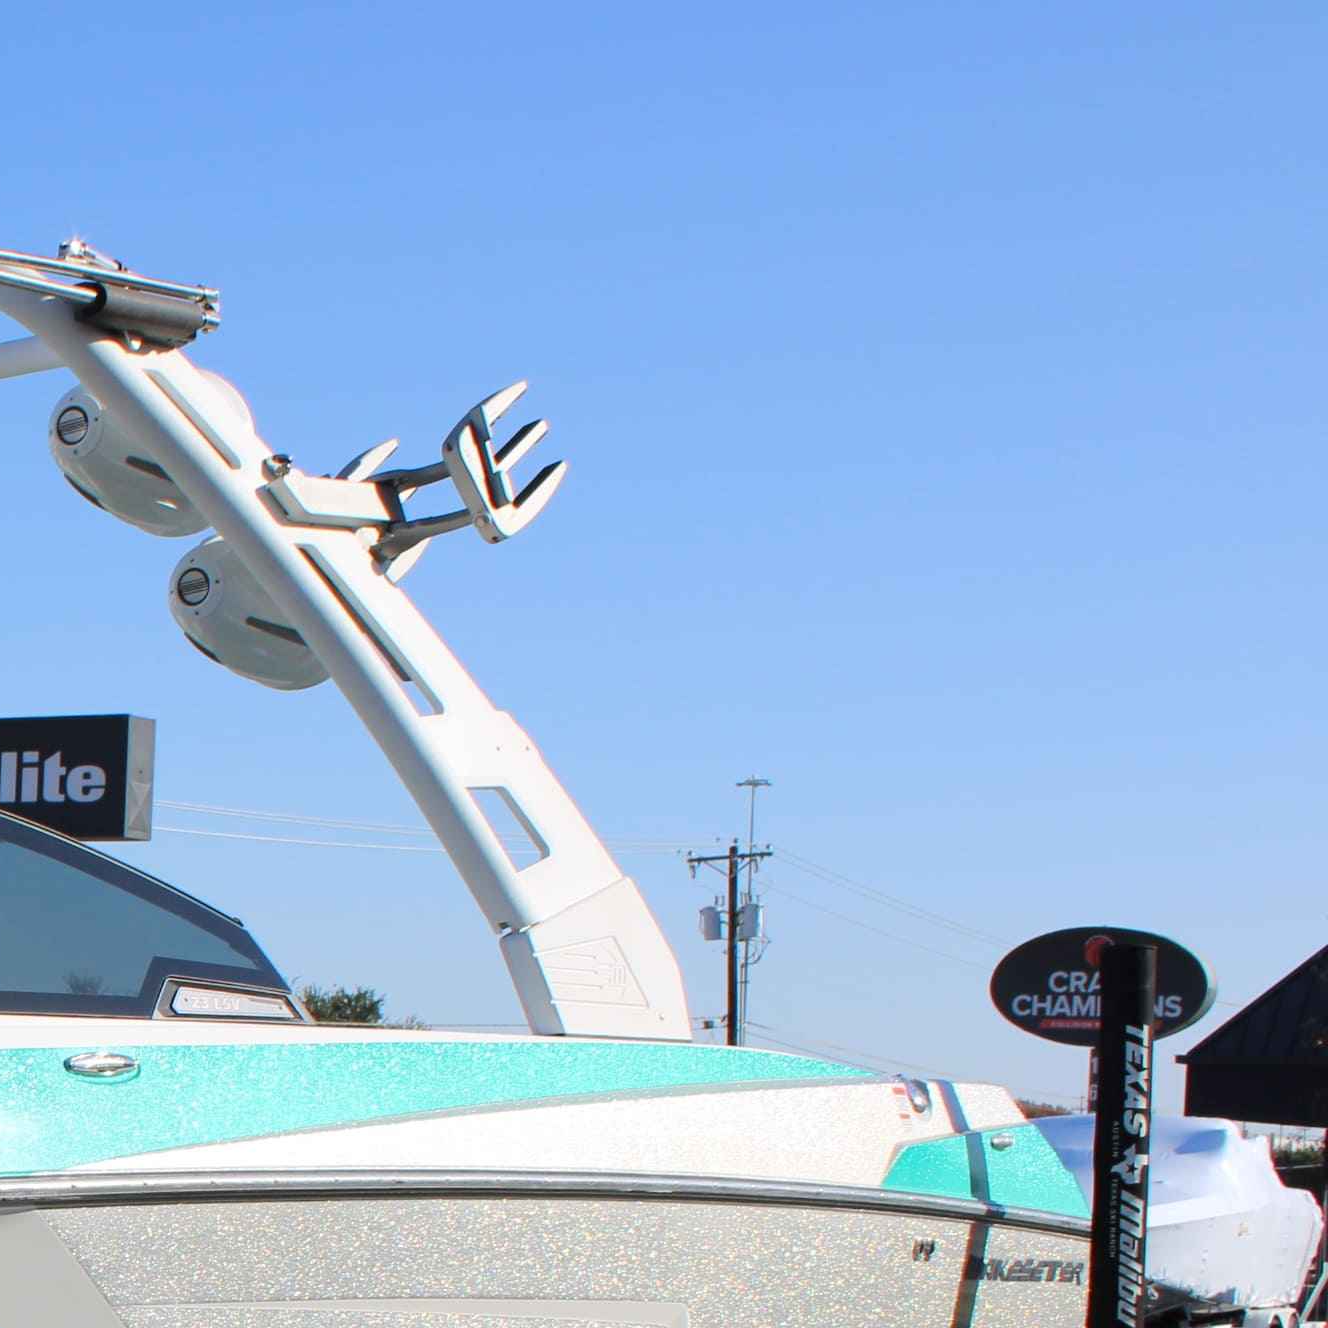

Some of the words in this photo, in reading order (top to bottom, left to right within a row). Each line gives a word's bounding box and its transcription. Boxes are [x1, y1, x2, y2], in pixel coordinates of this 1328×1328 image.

[1011, 994, 1182, 1018] CHAMNS
[1123, 1024, 1150, 1138] TEXAS
[1117, 1189, 1145, 1328] Malibu
